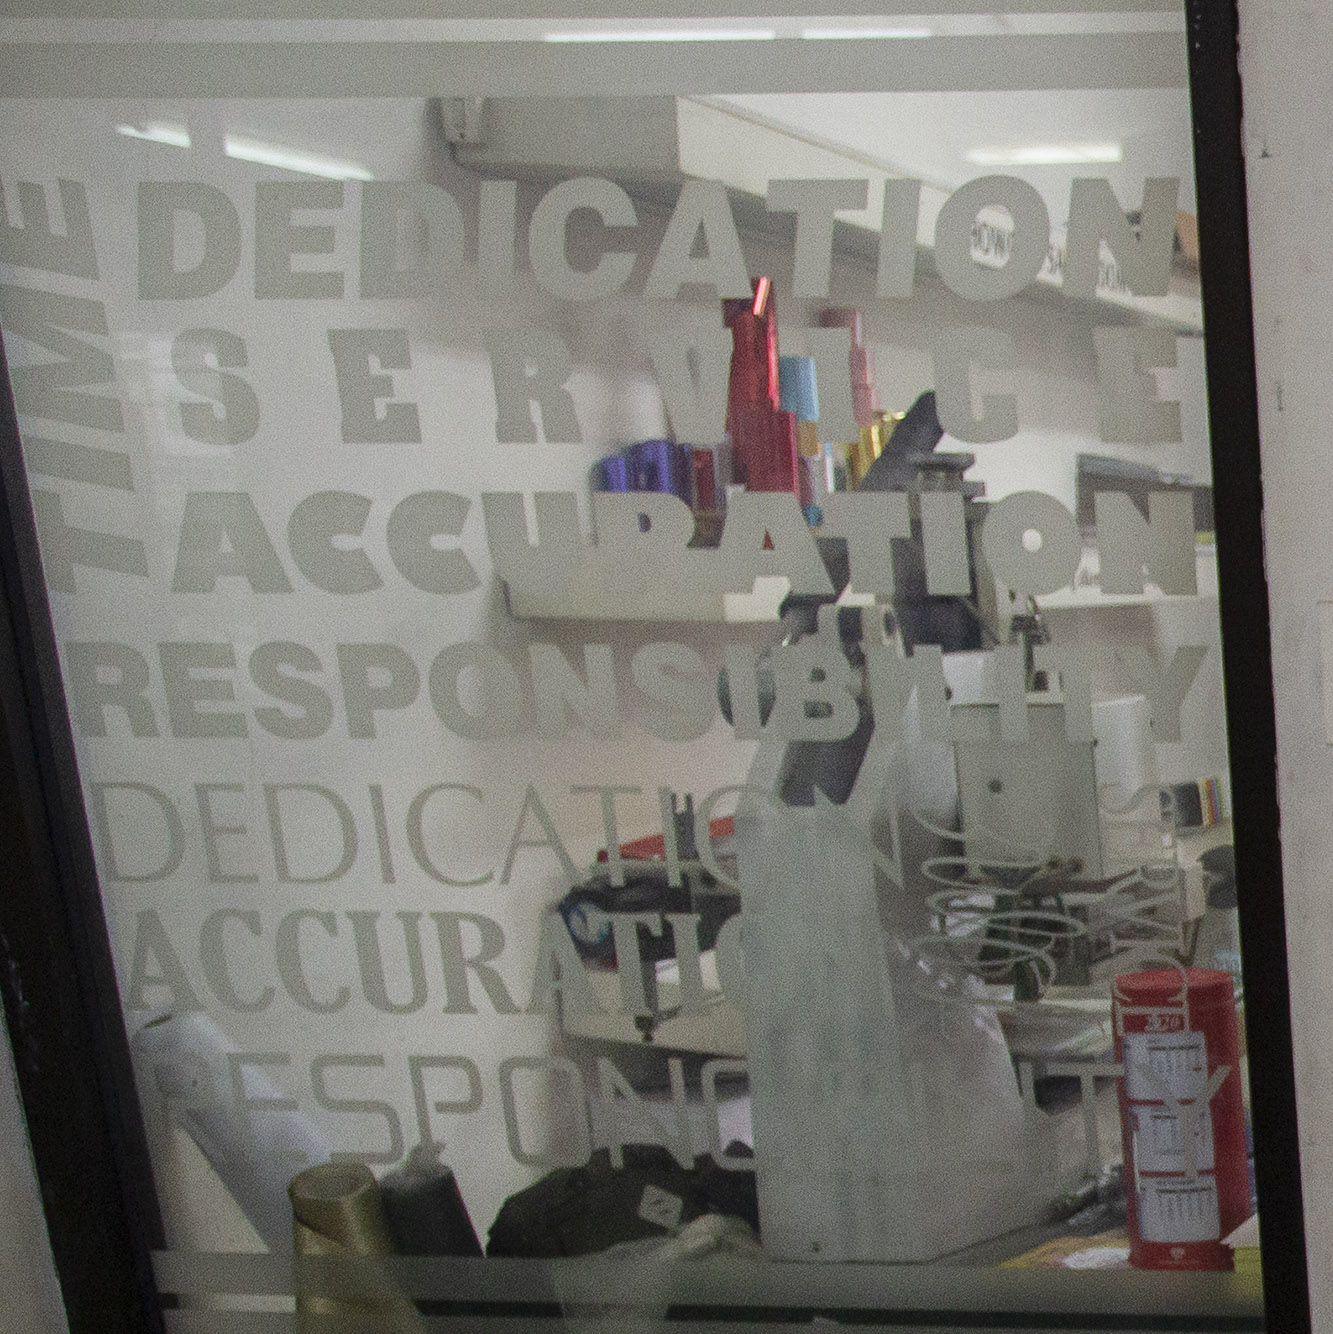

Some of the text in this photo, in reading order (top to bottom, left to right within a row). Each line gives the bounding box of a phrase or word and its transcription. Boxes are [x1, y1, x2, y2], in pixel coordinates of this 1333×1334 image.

[137, 173, 1180, 301] DEDICATION
[170, 327, 1183, 445] SERVICE
[171, 489, 1198, 596] ACCURATION
[65, 640, 1208, 741] RESPONSIBILITY
